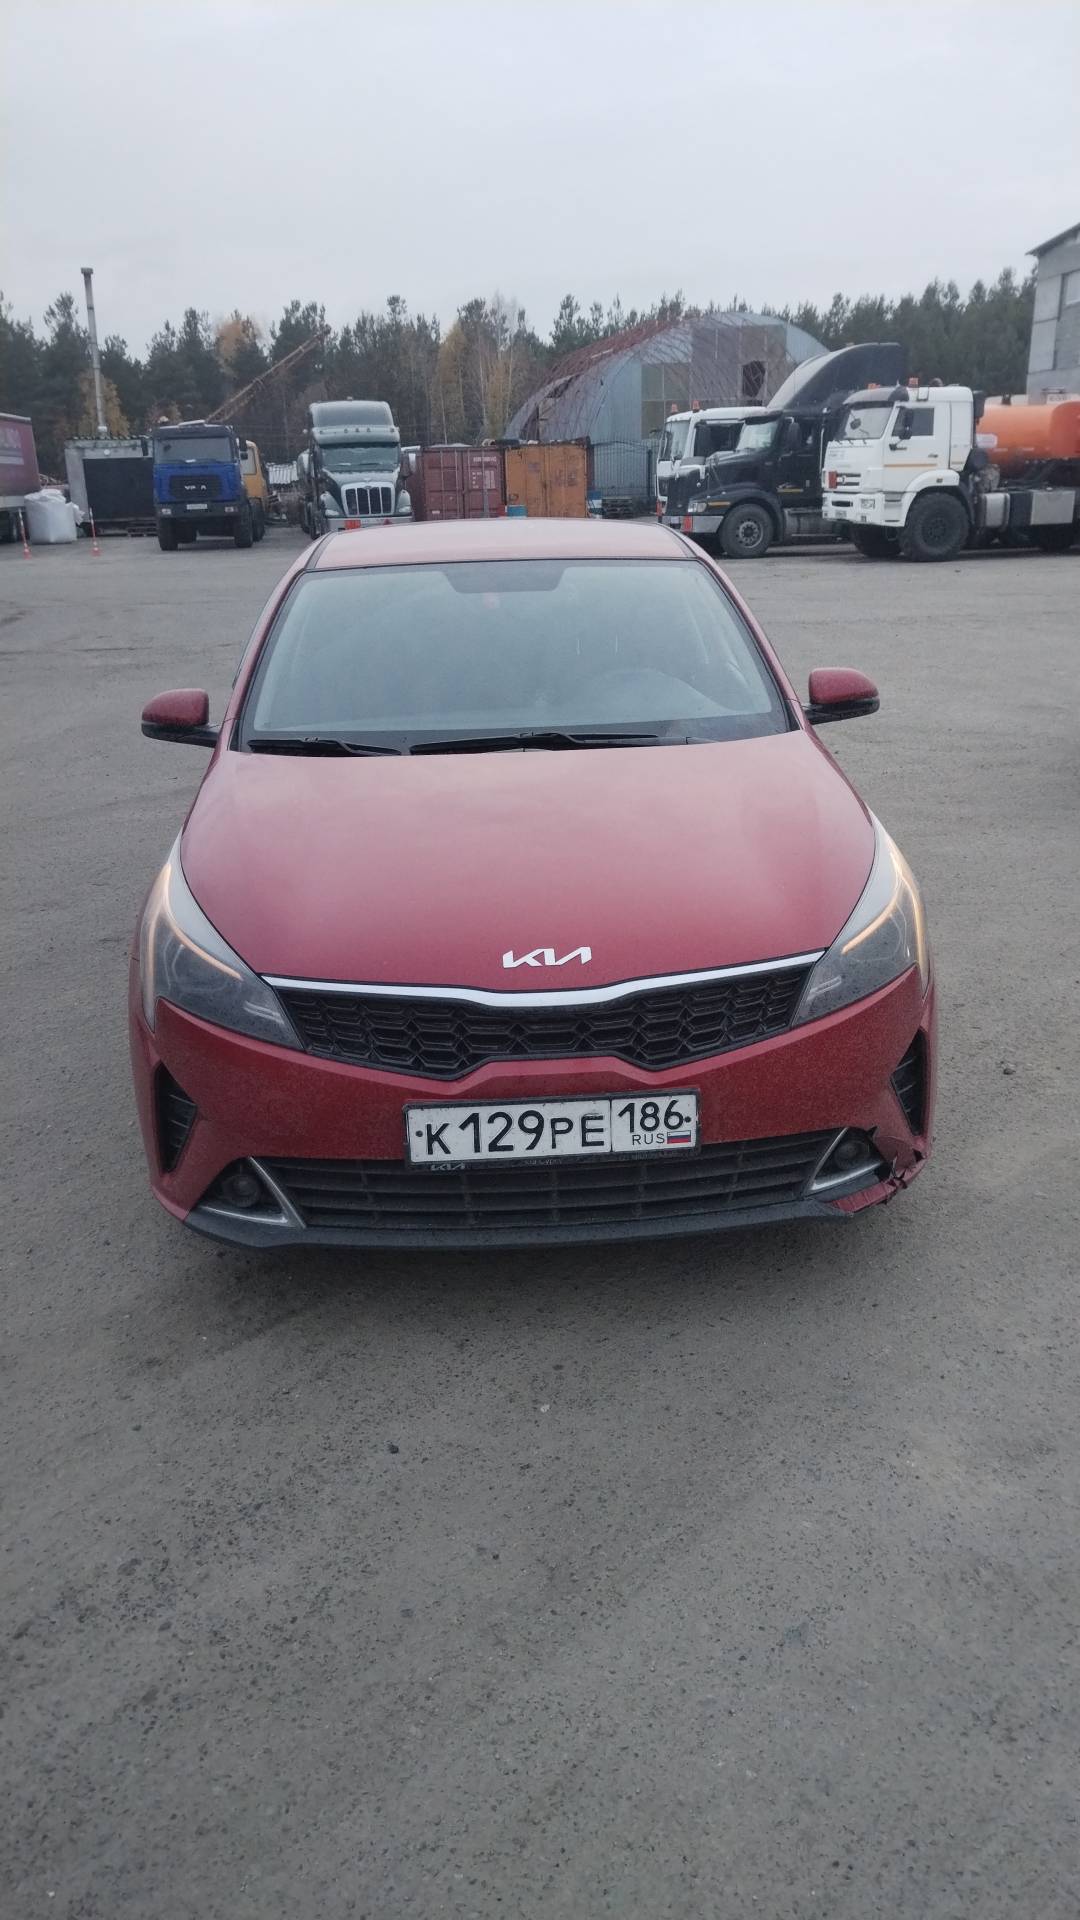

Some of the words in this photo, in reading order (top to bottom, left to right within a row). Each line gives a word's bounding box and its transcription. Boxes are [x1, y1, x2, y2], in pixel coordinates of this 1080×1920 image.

[502, 946, 592, 968] KIA
[617, 1099, 684, 1133] 186
[631, 1133, 666, 1146] RUS
